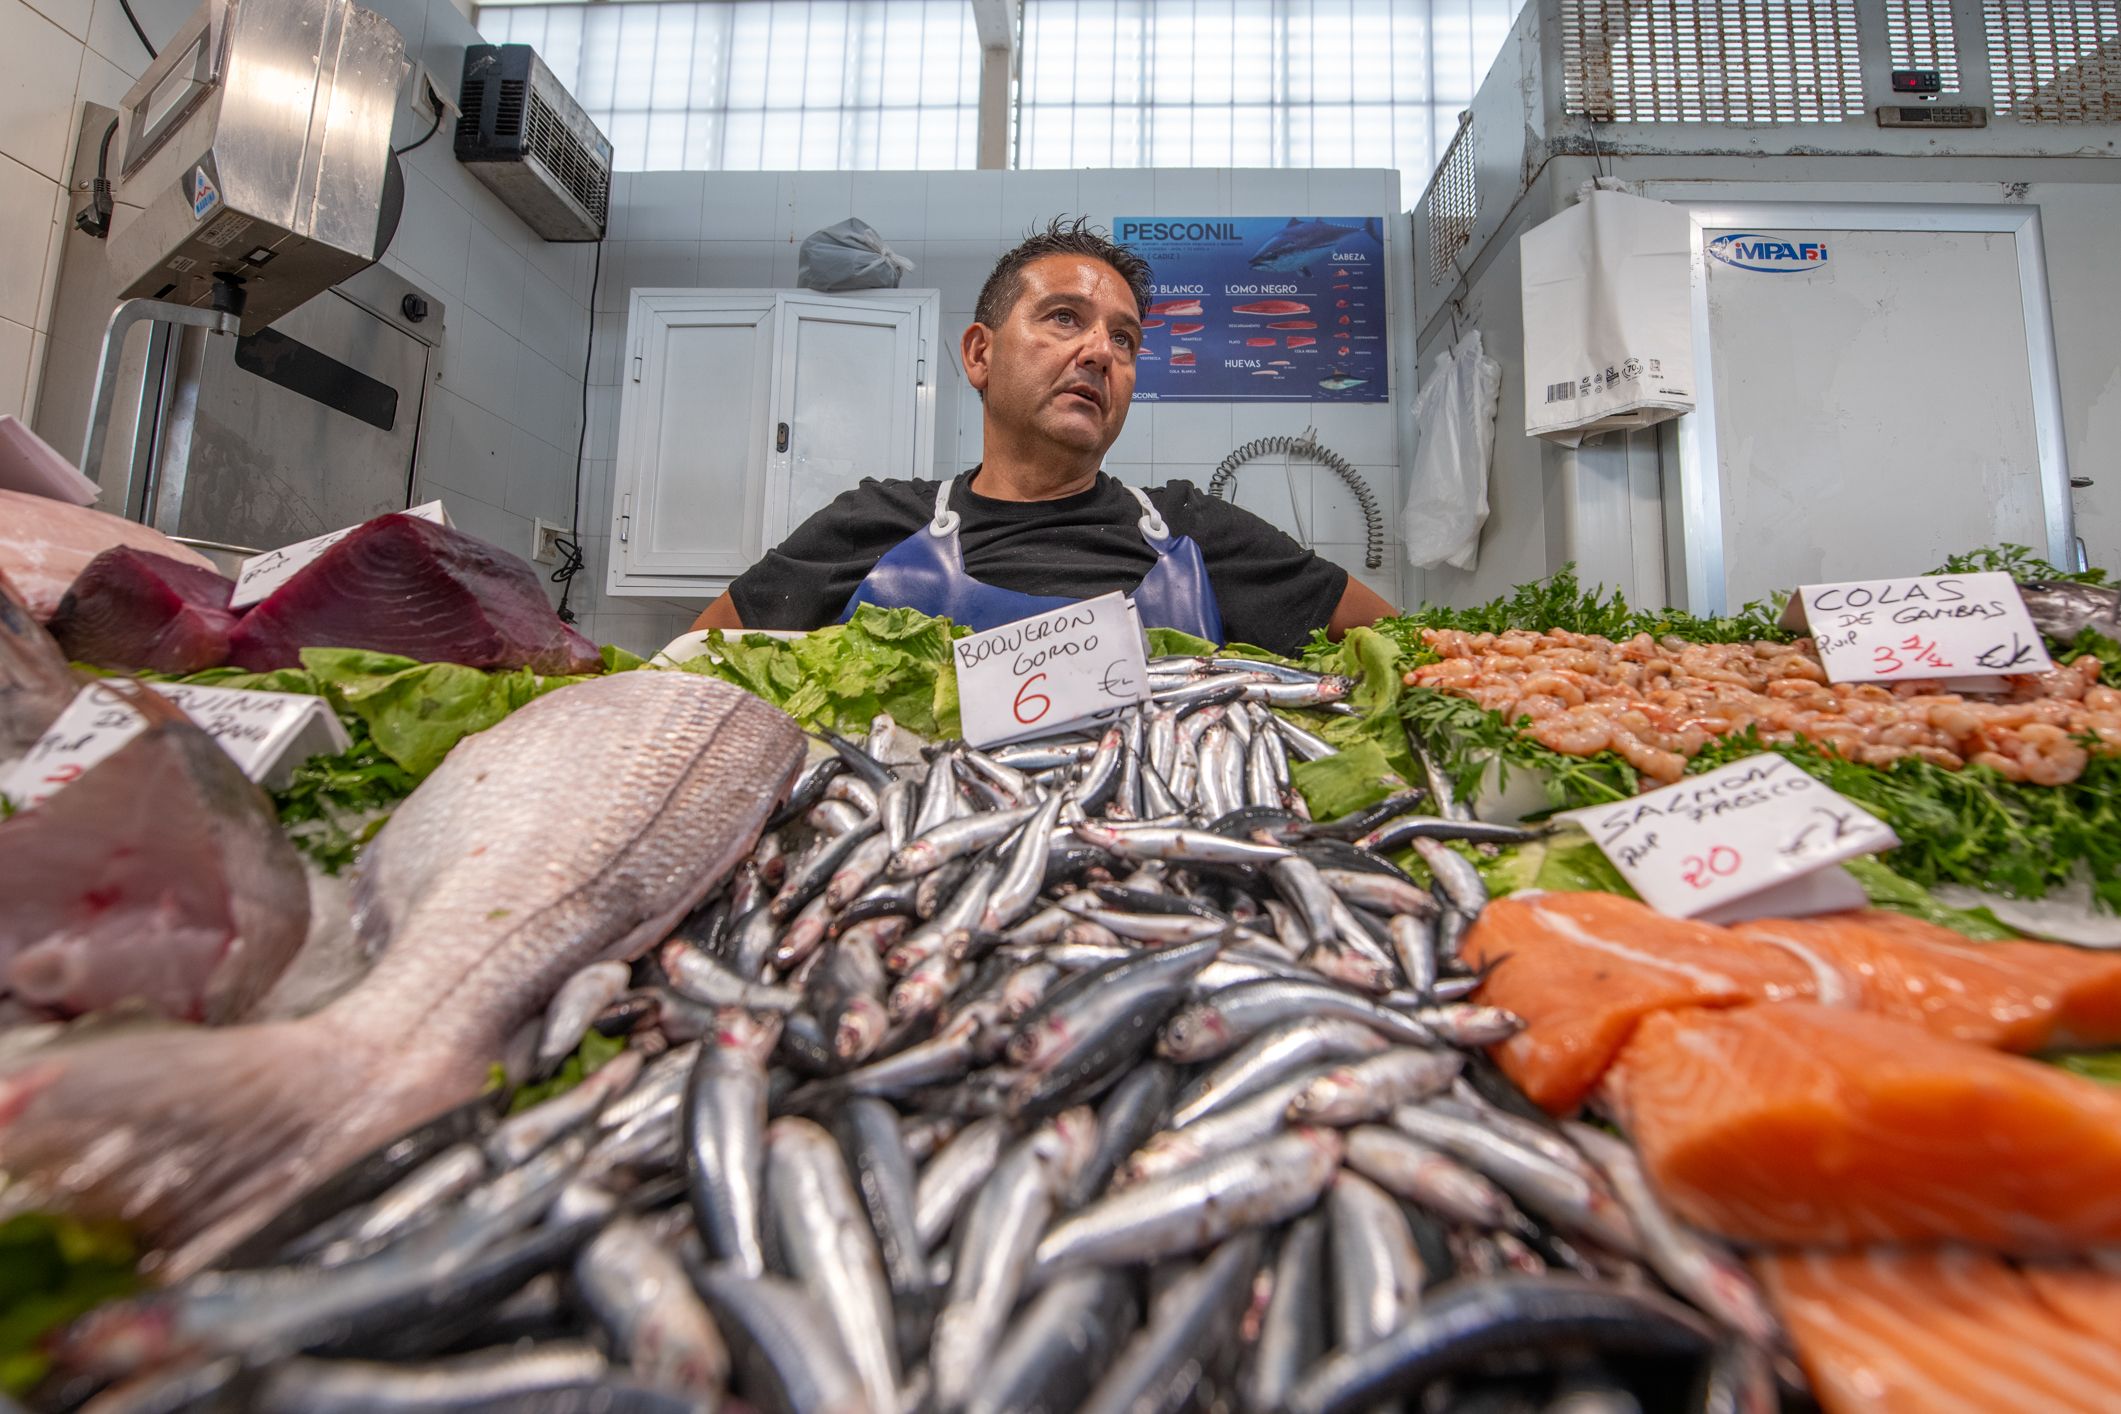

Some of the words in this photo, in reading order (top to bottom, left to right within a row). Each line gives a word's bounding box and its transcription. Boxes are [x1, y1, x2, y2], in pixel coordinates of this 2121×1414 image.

[1123, 223, 1243, 240] PESCONIL
[1332, 253, 1366, 261] CABEZA
[1160, 284, 1204, 294] BLANCO
[1225, 284, 1257, 294] LOMO
[1261, 284, 1298, 294] NEGRO
[1224, 359, 1261, 368] HUEVAS
[1814, 580, 1967, 611] COLAS
[1838, 611, 1875, 628] DE
[1892, 601, 2007, 625] GAMBAS
[958, 609, 1095, 668] BOQUERON
[1013, 635, 1098, 675] GORDO
[1013, 673, 1051, 724] 6
[1602, 758, 1785, 846] SALMON
[1681, 844, 1743, 889] 20
